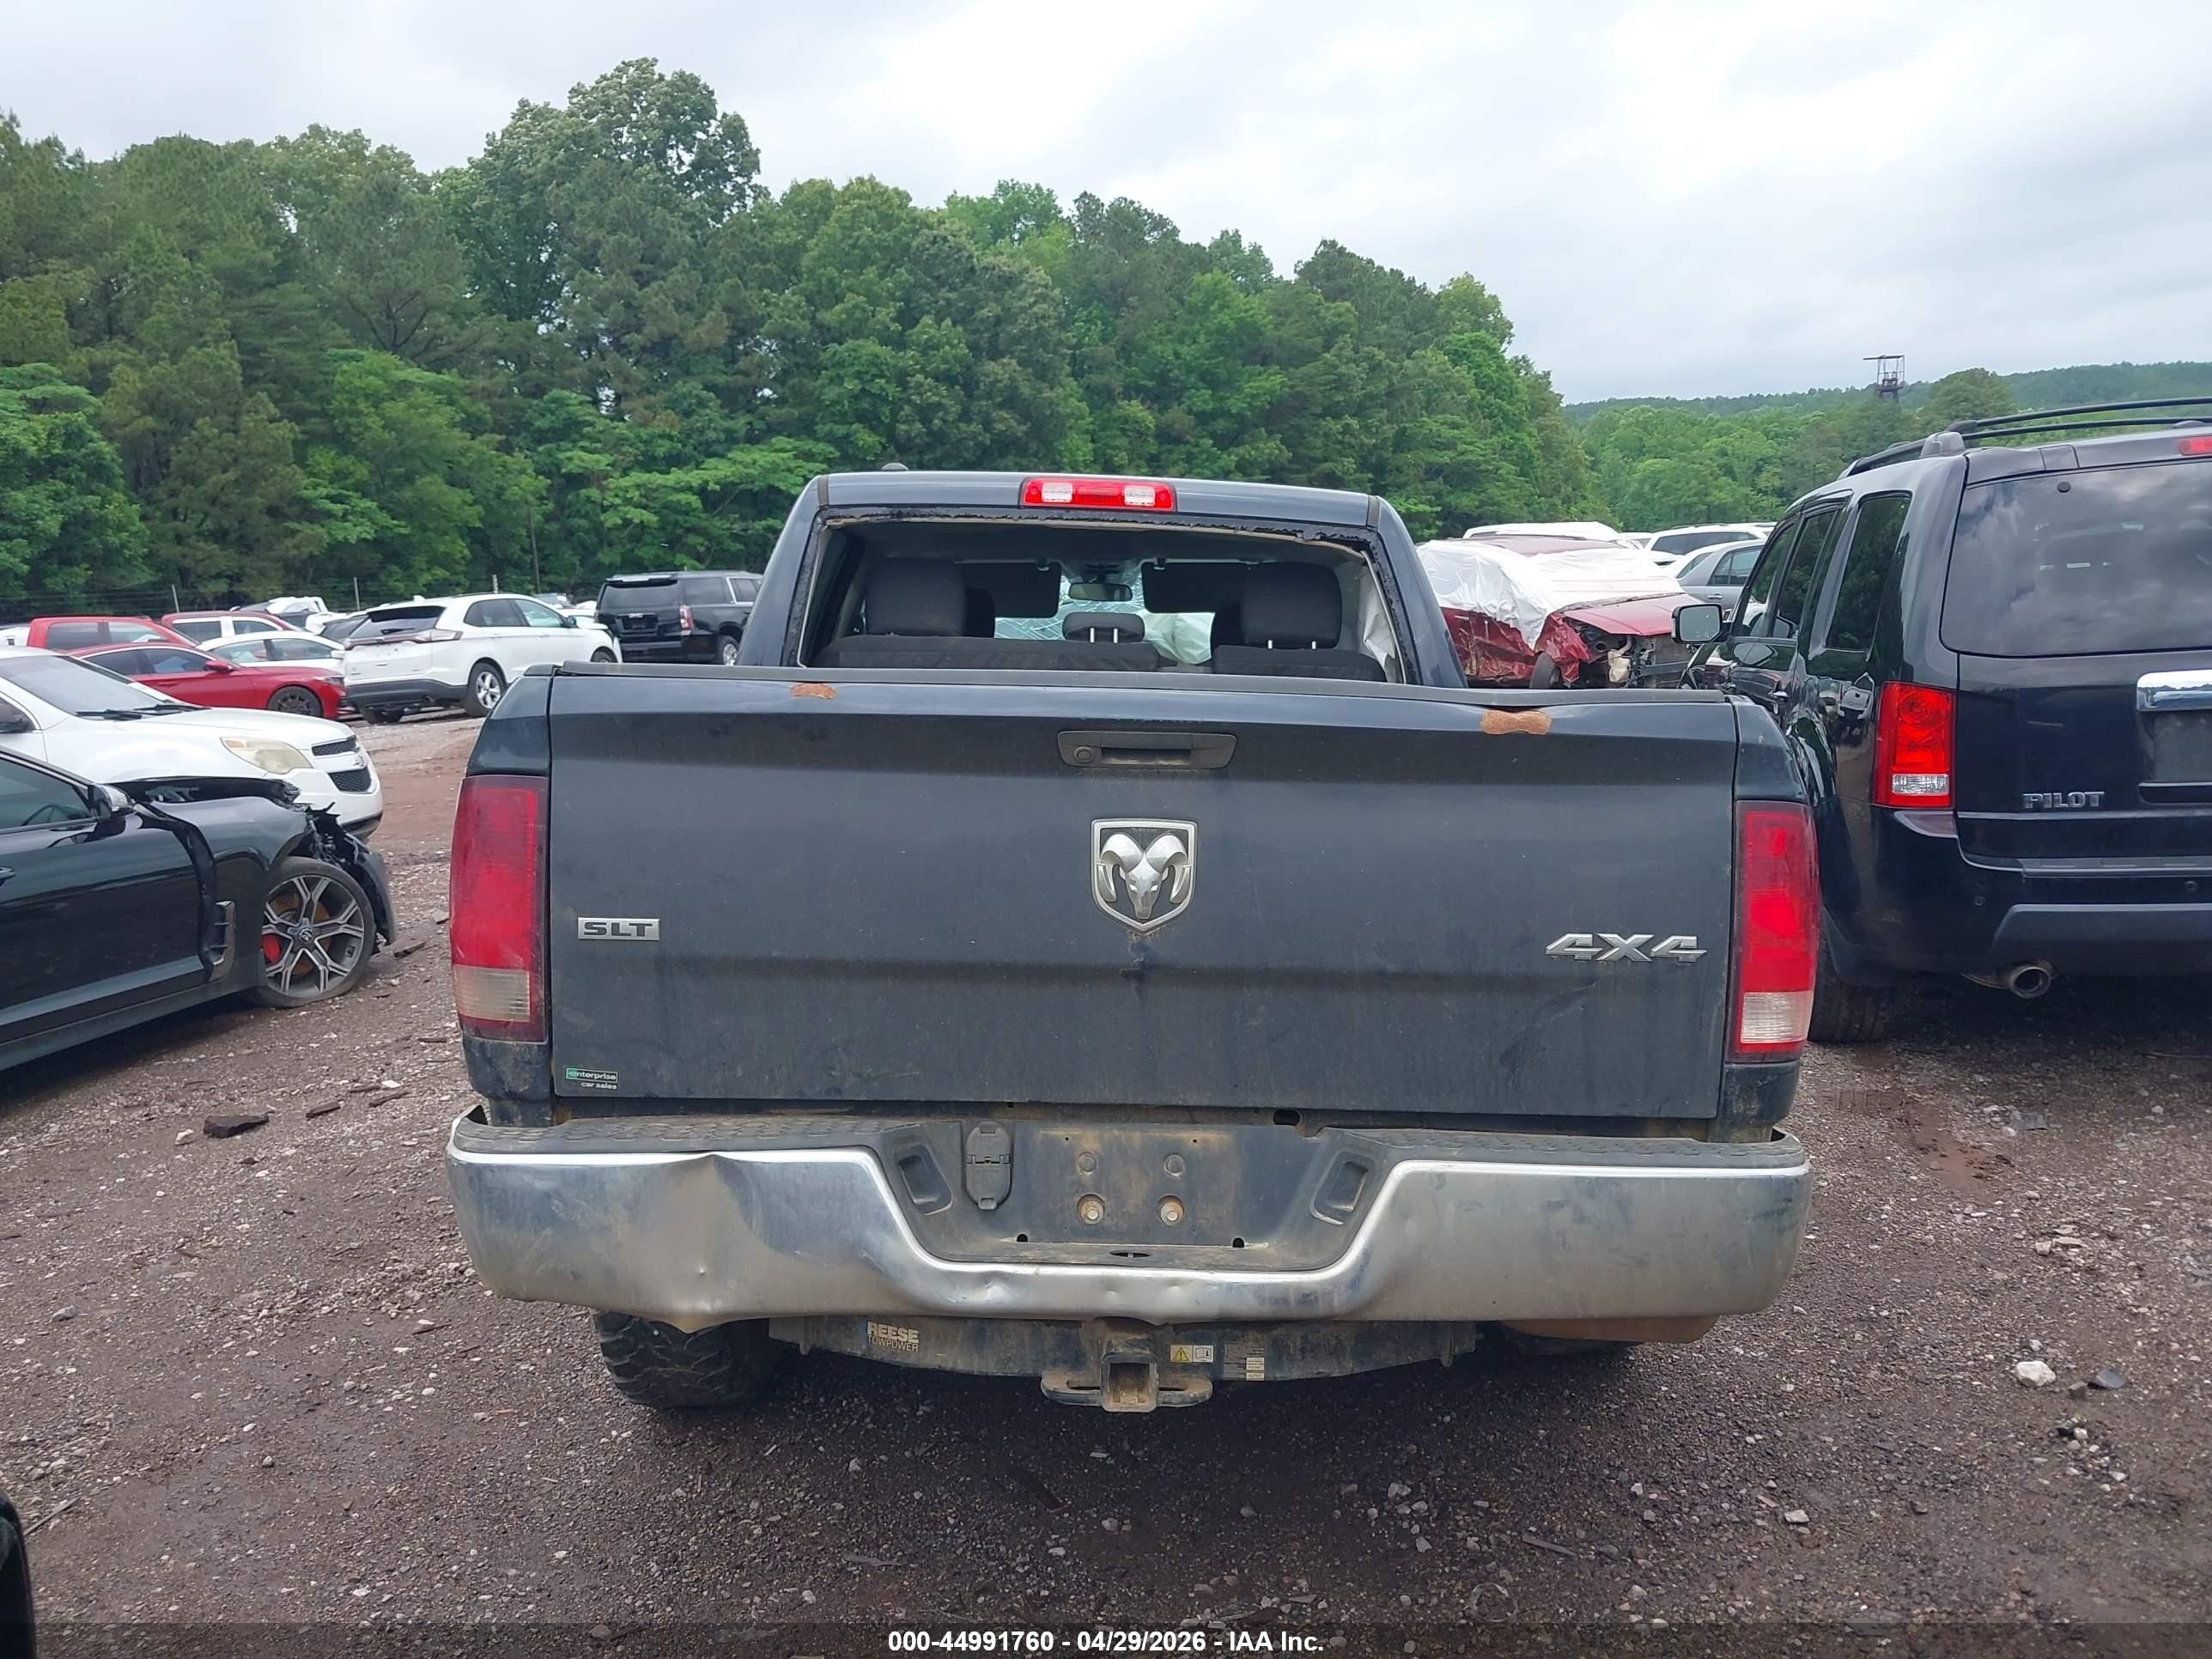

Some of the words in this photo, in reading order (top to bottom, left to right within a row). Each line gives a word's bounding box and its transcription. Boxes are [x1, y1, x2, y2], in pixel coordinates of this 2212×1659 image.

[2022, 791, 2106, 808] PILOT
[583, 921, 653, 937] SLT
[1545, 933, 1707, 963] 4X4
[568, 1070, 617, 1080] enterprise
[866, 1321, 920, 1344] REESE
[866, 1334, 919, 1352] TOWPOWER
